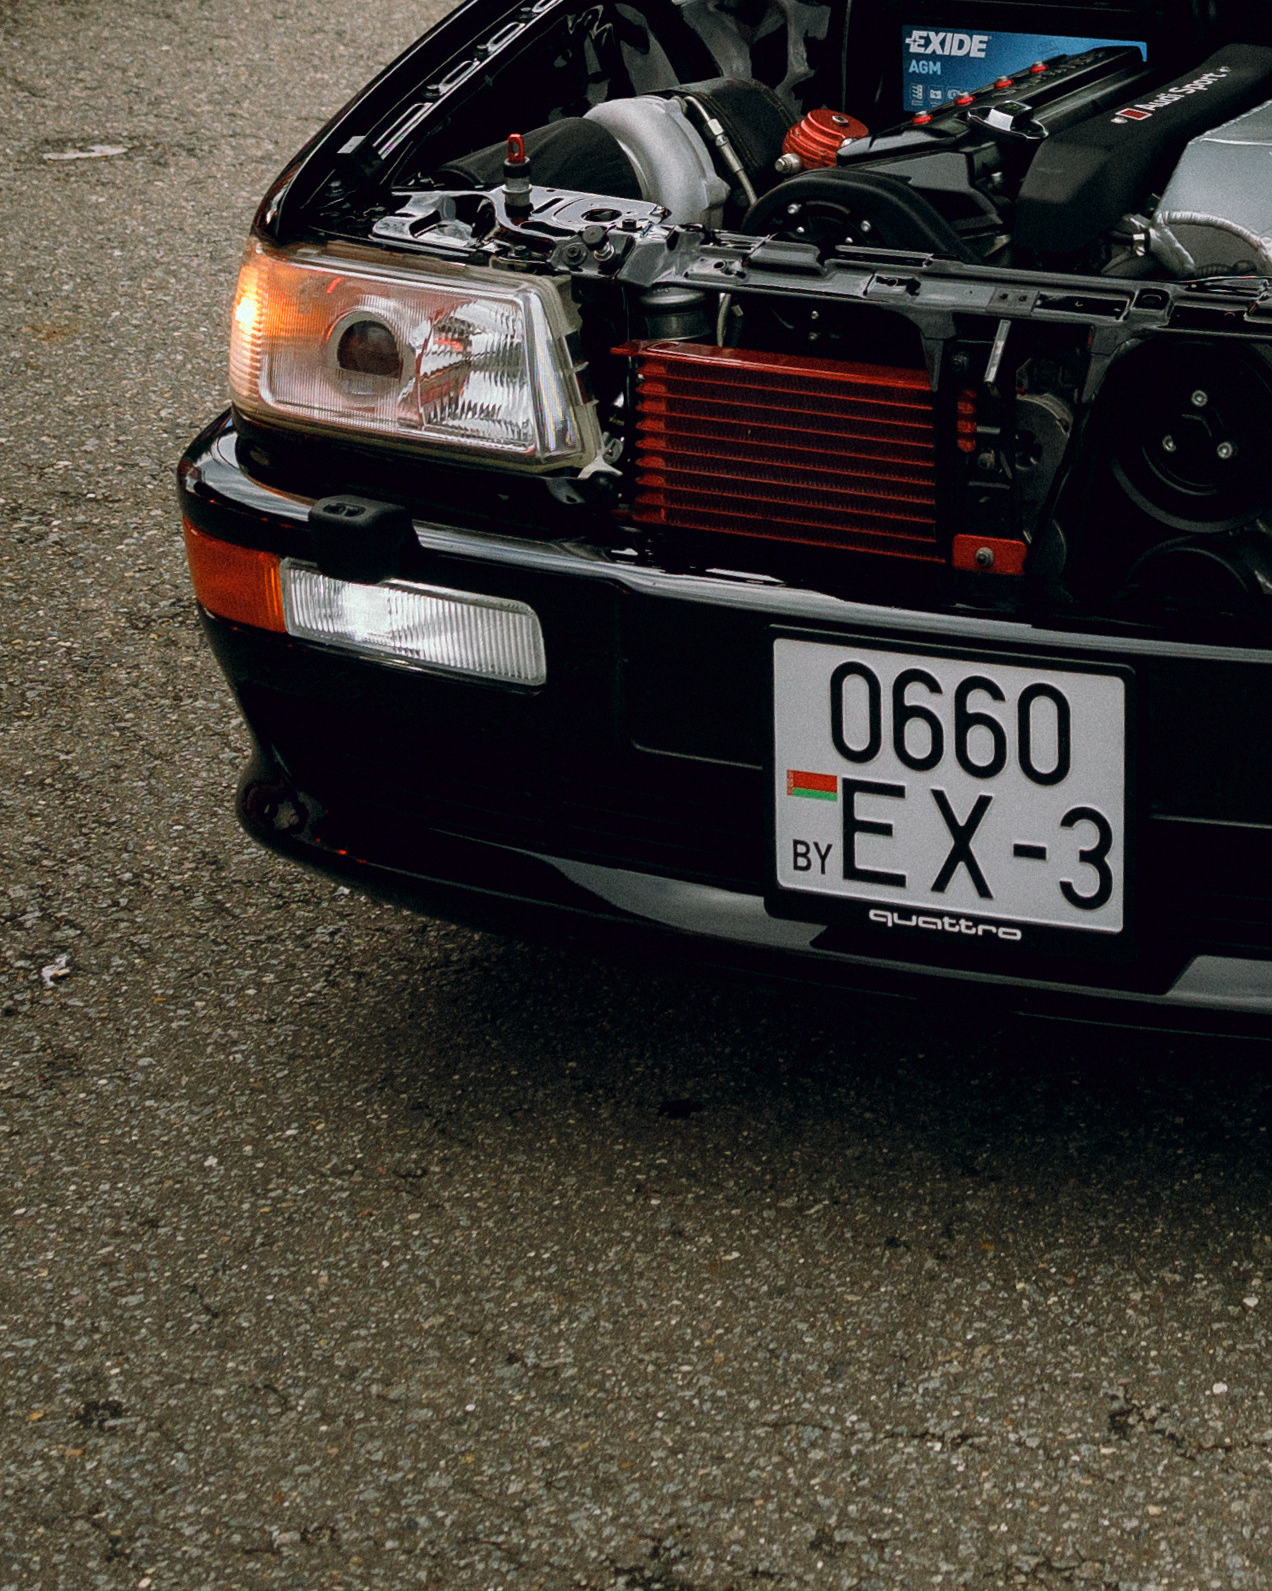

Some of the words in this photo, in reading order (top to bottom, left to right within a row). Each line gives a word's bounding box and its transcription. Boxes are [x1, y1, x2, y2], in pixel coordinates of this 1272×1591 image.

[905, 30, 989, 58] EXIDE
[908, 59, 942, 75] AGM
[1134, 92, 1185, 111] Audi
[1168, 72, 1228, 94] Sport
[829, 661, 1071, 787] 0660
[792, 838, 833, 875] BY
[841, 777, 1113, 911] EX-3
[868, 908, 1022, 941] quattro
